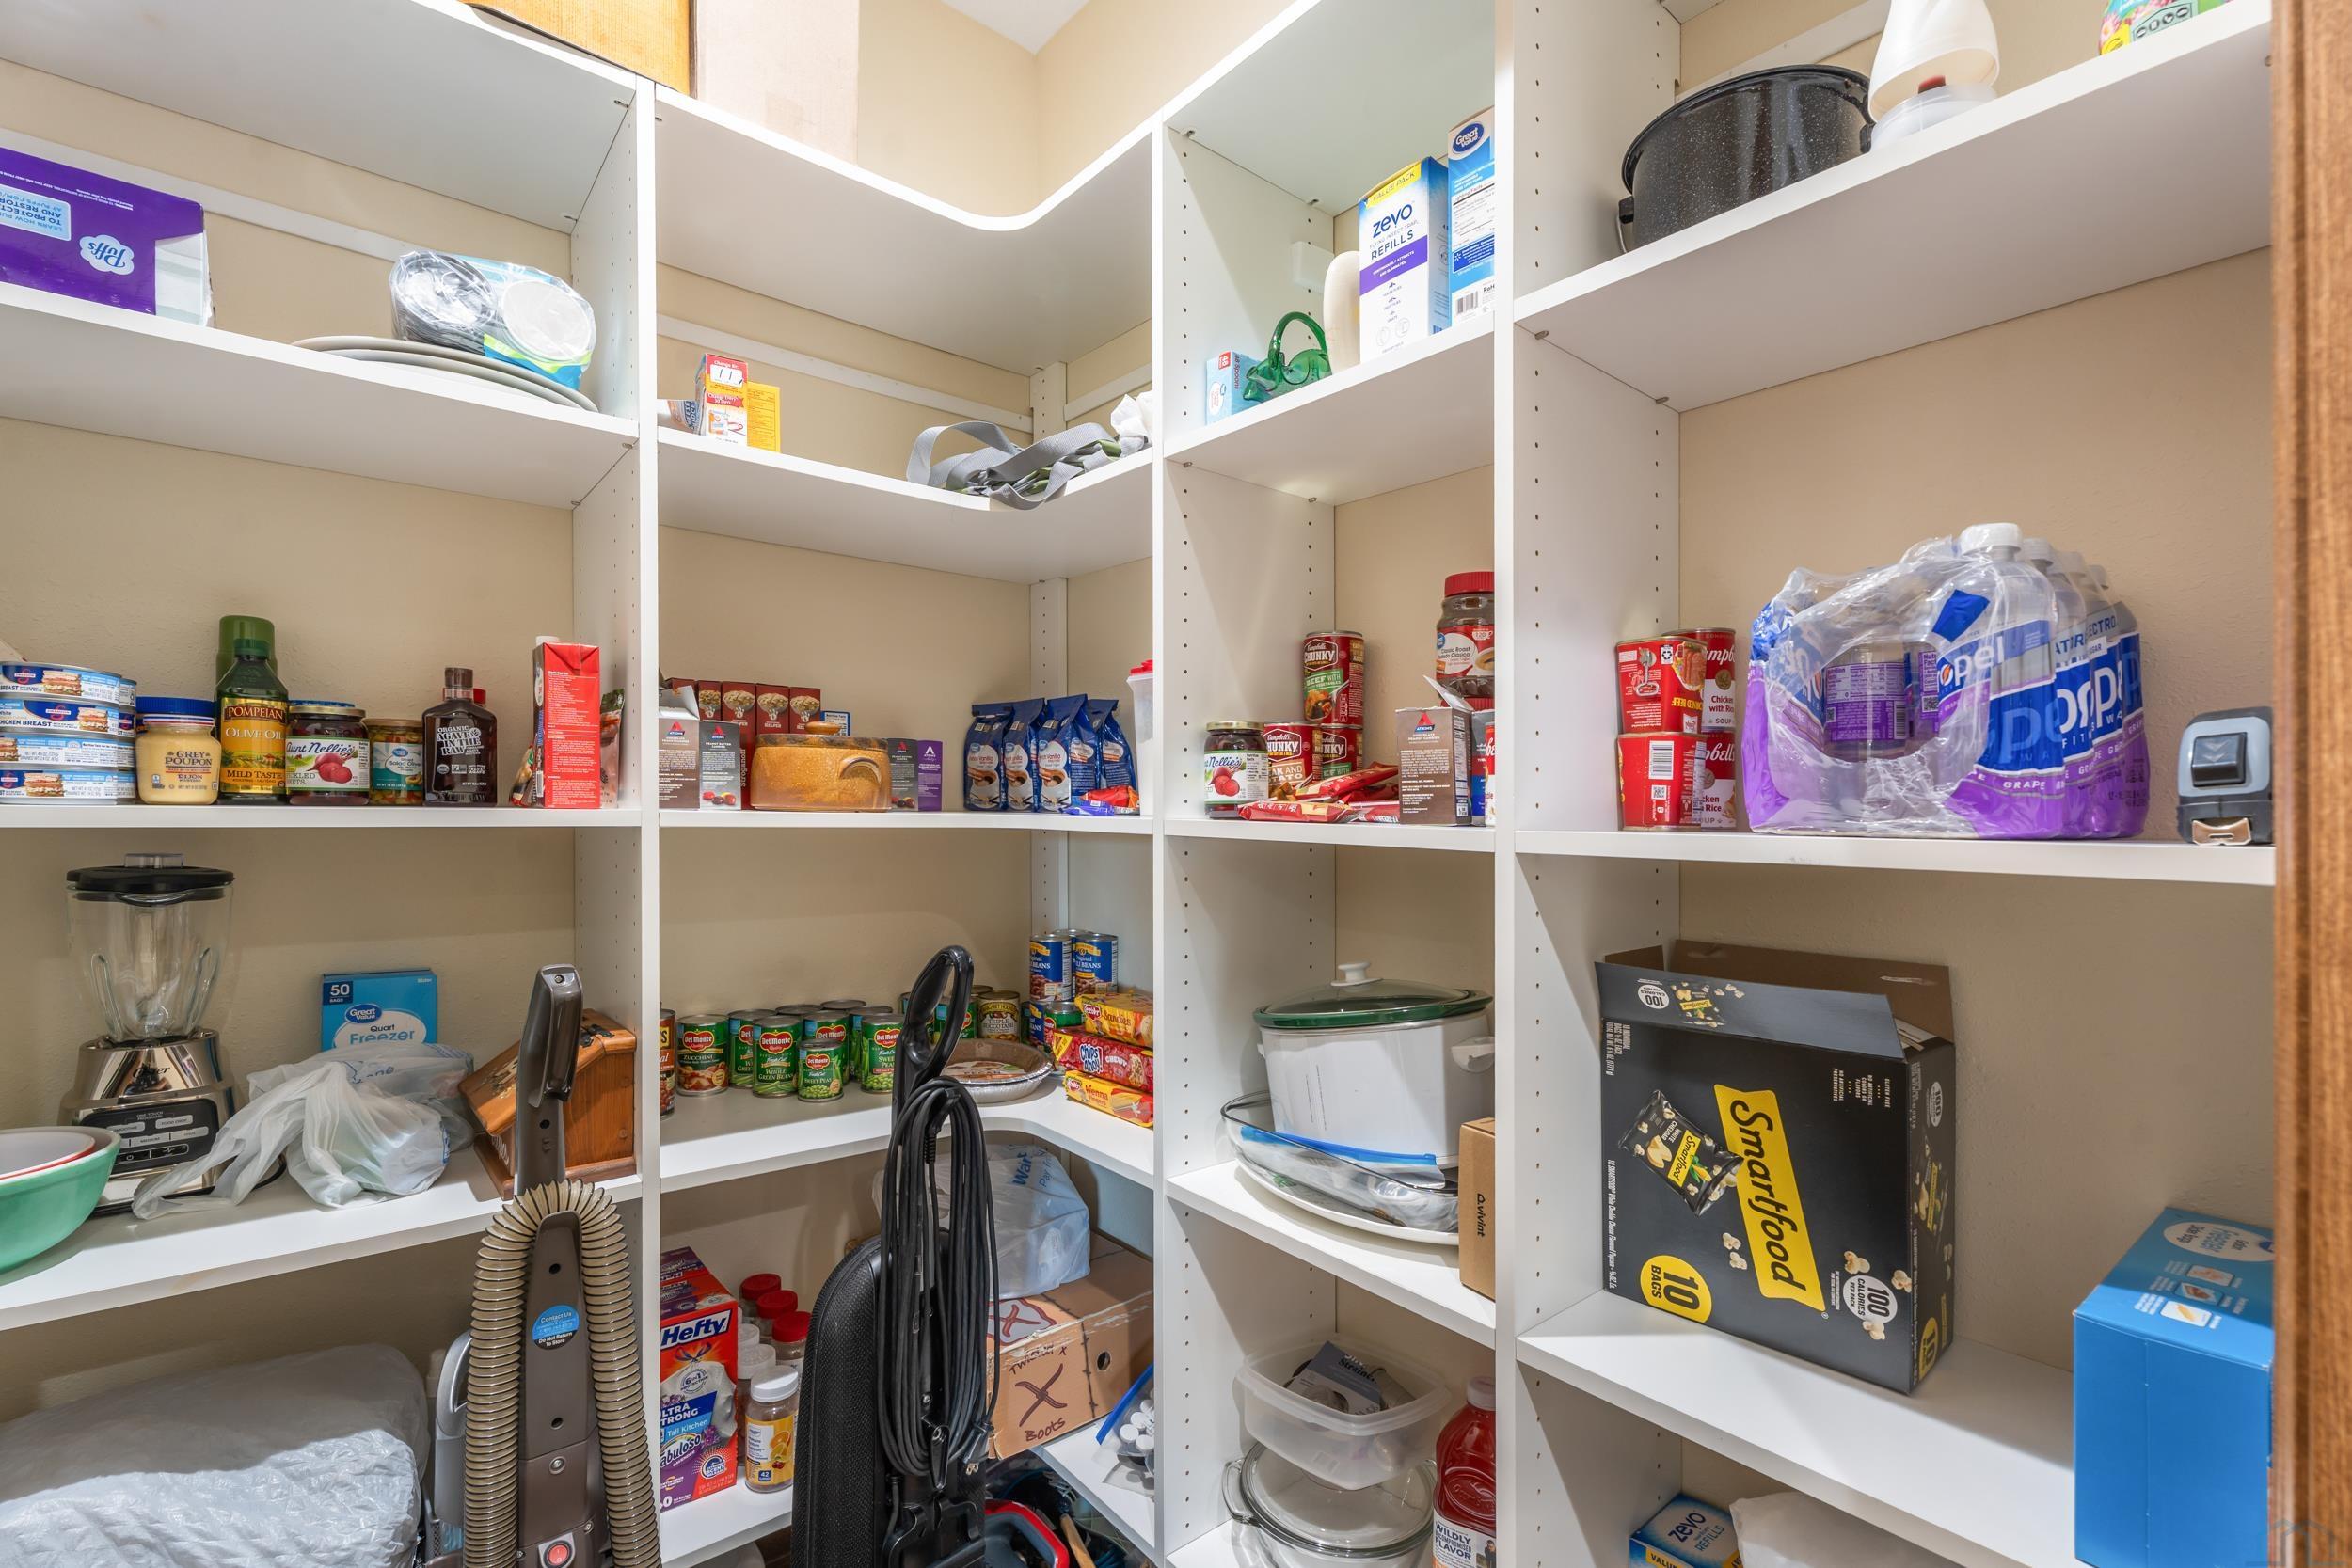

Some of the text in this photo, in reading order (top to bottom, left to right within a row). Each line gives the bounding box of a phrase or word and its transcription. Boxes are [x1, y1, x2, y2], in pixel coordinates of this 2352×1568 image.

[0, 191, 51, 209] PUFFS.COM/
[0, 205, 62, 226] TO PROTECT
[15, 215, 36, 225] HOW
[41, 209, 62, 219] AND
[1372, 203, 1413, 239] zevo
[1371, 230, 1414, 261] REFILLS
[88, 242, 127, 269] Puffs
[1304, 650, 1335, 663] CHUNKY
[1306, 675, 1327, 687] BEEF
[1671, 696, 1687, 708] BEEF
[1708, 703, 1725, 712] with
[228, 706, 282, 720] POMPEIAN
[225, 728, 282, 740] OLIVE OIL
[437, 732, 470, 741] AGAVE
[459, 737, 482, 746] THE
[176, 751, 205, 759] GREY
[308, 741, 354, 754] Nellie's
[441, 746, 467, 756] RAW
[165, 756, 213, 767] POUPON
[1209, 756, 1241, 768] Nellie's
[1285, 763, 1302, 774] AND
[227, 769, 282, 779] MILD TASTE
[2003, 780, 2045, 791] GRAPE
[330, 983, 350, 996] 50
[1645, 995, 1665, 1007] 100
[349, 1007, 376, 1017] Great
[1104, 1010, 1133, 1026] Sandies
[370, 1024, 395, 1033] Quart
[350, 1030, 416, 1045] Freezer
[1080, 1044, 1099, 1062] Chips
[1084, 1053, 1104, 1073] Ahoy!
[1104, 1054, 1128, 1068] CHEWY
[1085, 1085, 1108, 1101] Vienna
[1661, 1120, 1678, 1141] CHEDDAR
[1668, 1128, 1682, 1144] WHITE
[1673, 1135, 1696, 1180] Smartfood
[1729, 1099, 1806, 1292] Smartfood
[1476, 1204, 1486, 1238] vivint
[1649, 1264, 1663, 1299] BAGS
[1662, 1275, 1700, 1311] 10
[1857, 1277, 1866, 1316] CALORIES
[1867, 1287, 1890, 1318] 100
[540, 1313, 564, 1323] Contact
[660, 1317, 727, 1347] Hefty
[667, 1418, 708, 1437] Tall Kitchen
[1025, 1417, 1066, 1443] Boots
[1436, 1523, 1472, 1545] WILDLY
[1668, 1512, 1707, 1543] zevo
[1694, 1524, 1725, 1552] REFILLS
[1435, 1540, 1472, 1561] FLAVOR
